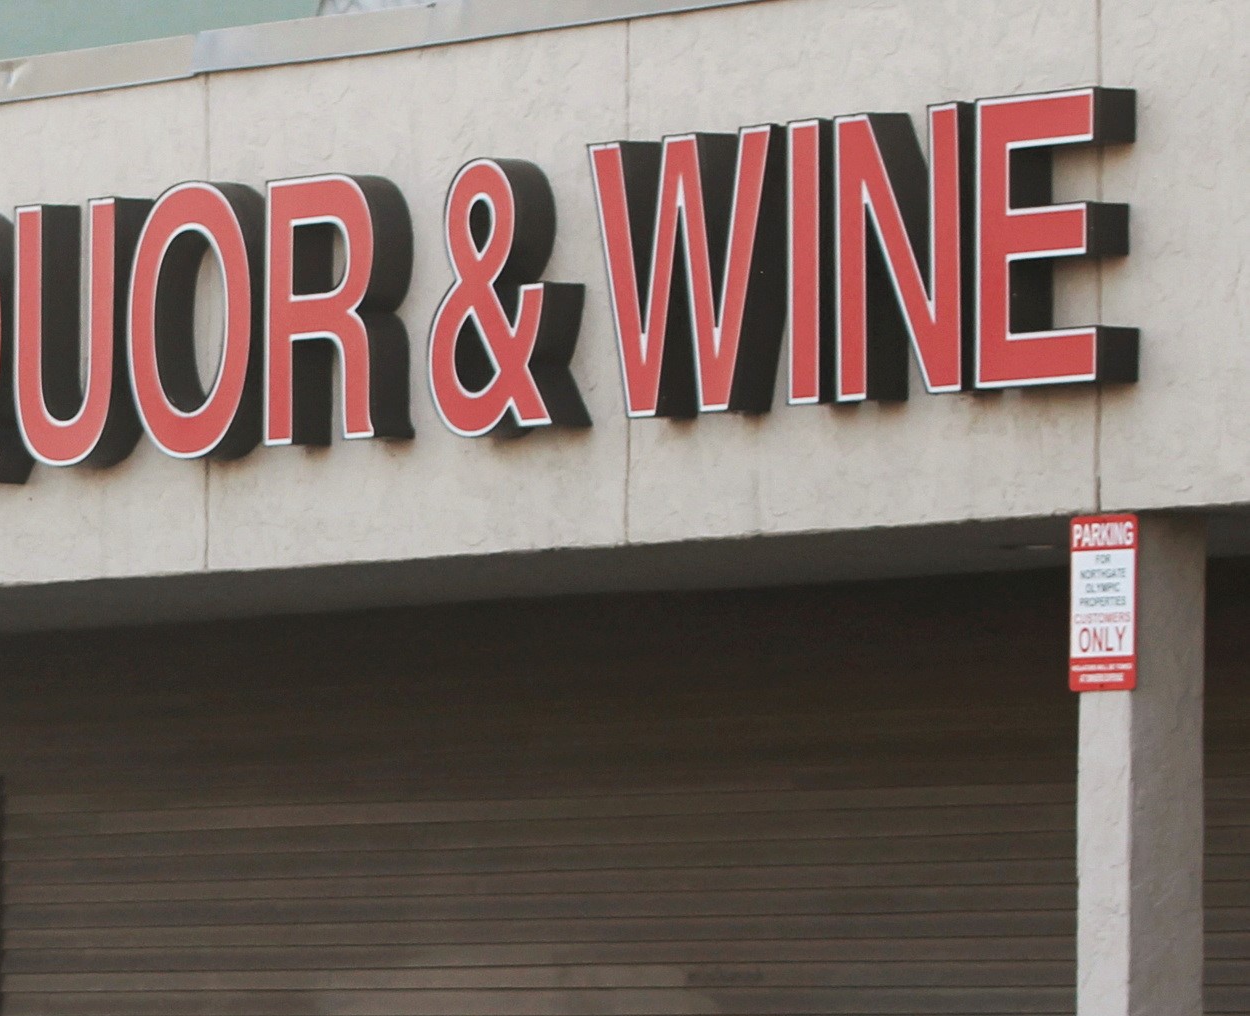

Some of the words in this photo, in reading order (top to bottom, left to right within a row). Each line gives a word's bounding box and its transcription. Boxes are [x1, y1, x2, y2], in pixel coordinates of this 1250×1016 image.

[429, 159, 554, 438] &
[587, 88, 1100, 418] WINE
[1072, 521, 1134, 547] PARKING
[1095, 554, 1111, 564] FOR
[1080, 568, 1126, 579] NORTHGATE
[1085, 582, 1120, 593] OLYMPIC
[1079, 596, 1126, 606] PROPERTIES
[1074, 612, 1131, 624] CUSTOMERS
[1079, 626, 1127, 652] ONLY
